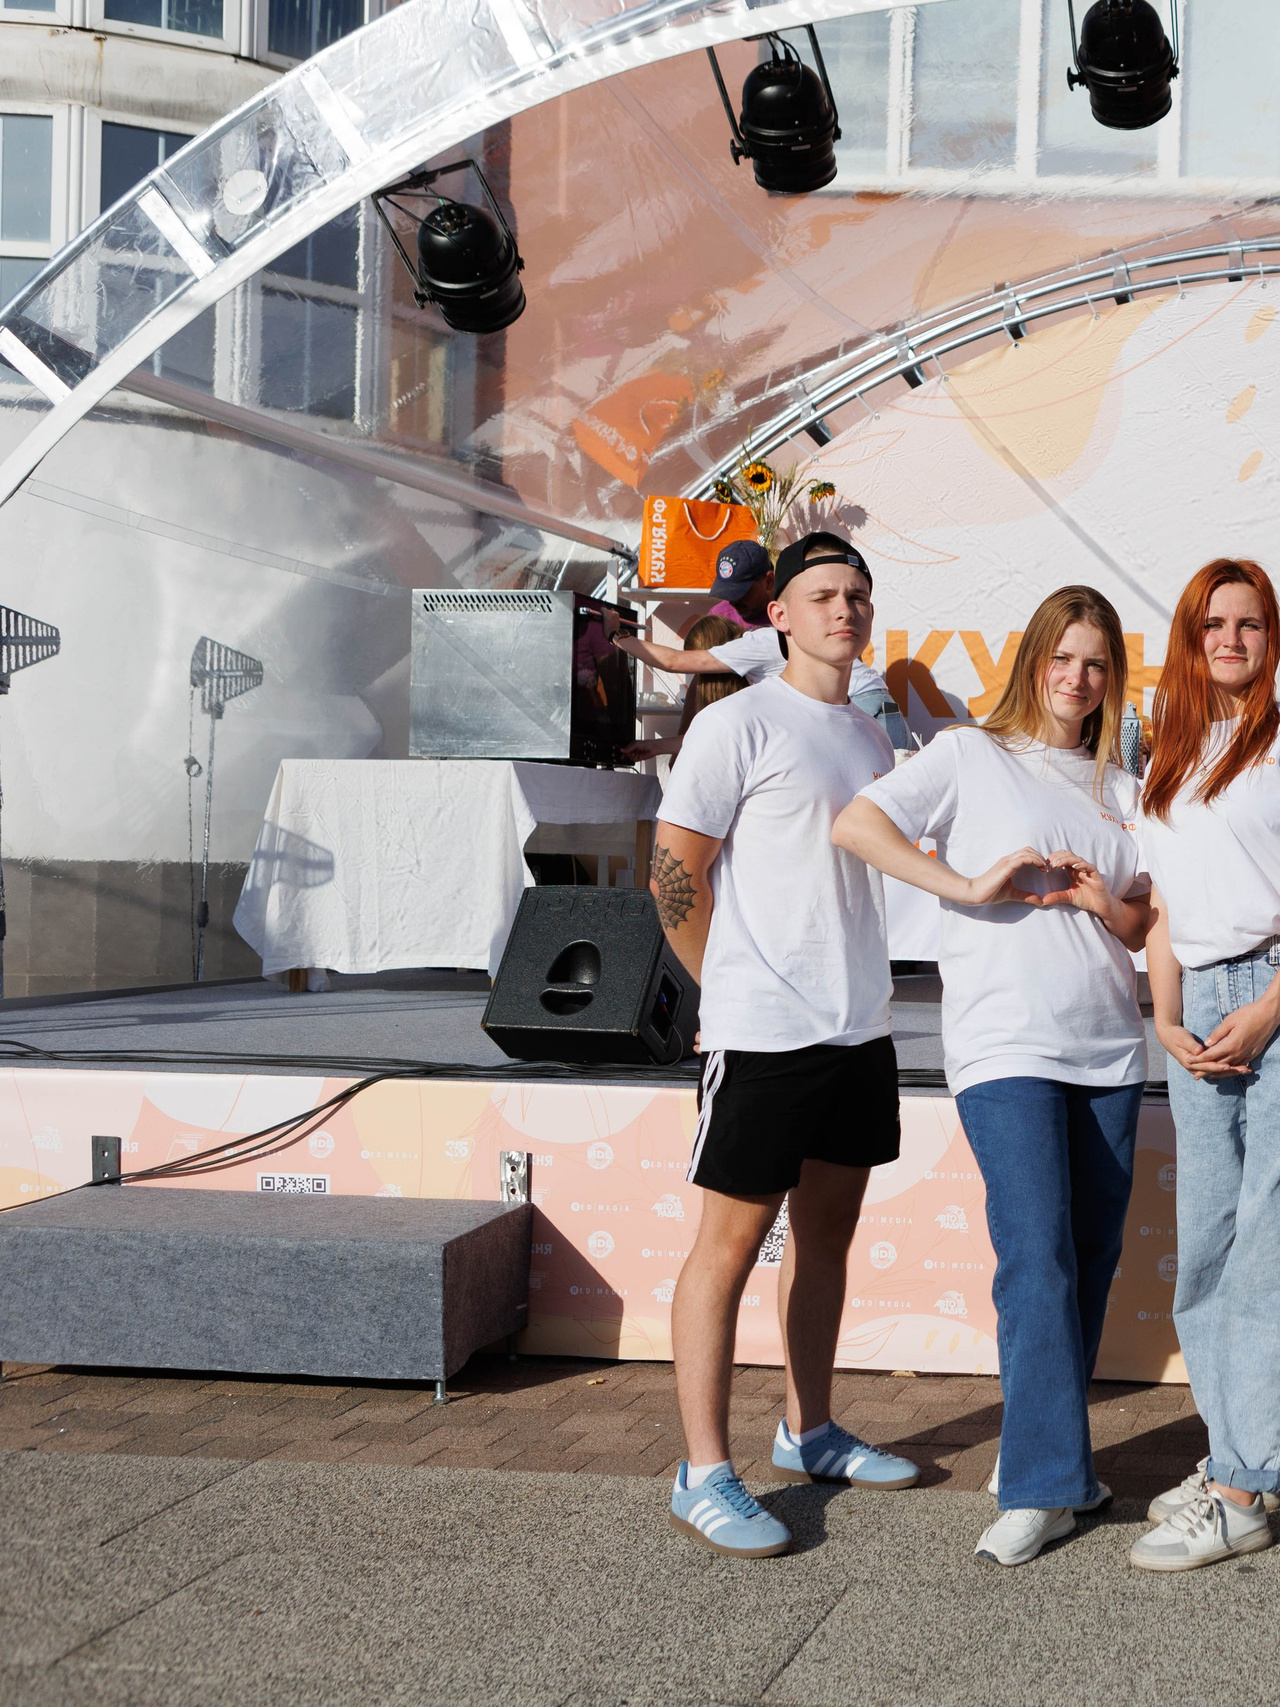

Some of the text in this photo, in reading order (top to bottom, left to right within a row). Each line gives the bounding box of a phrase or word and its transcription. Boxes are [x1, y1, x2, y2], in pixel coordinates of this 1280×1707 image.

[651, 498, 667, 584] КУХНЯ.РФ
[527, 1155, 553, 1166] ХНЯ
[668, 1161, 688, 1169] MED
[46, 1185, 67, 1193] MED
[858, 1215, 874, 1224] ED
[951, 1262, 984, 1270] MEDIA
[657, 1295, 673, 1303] РАД
